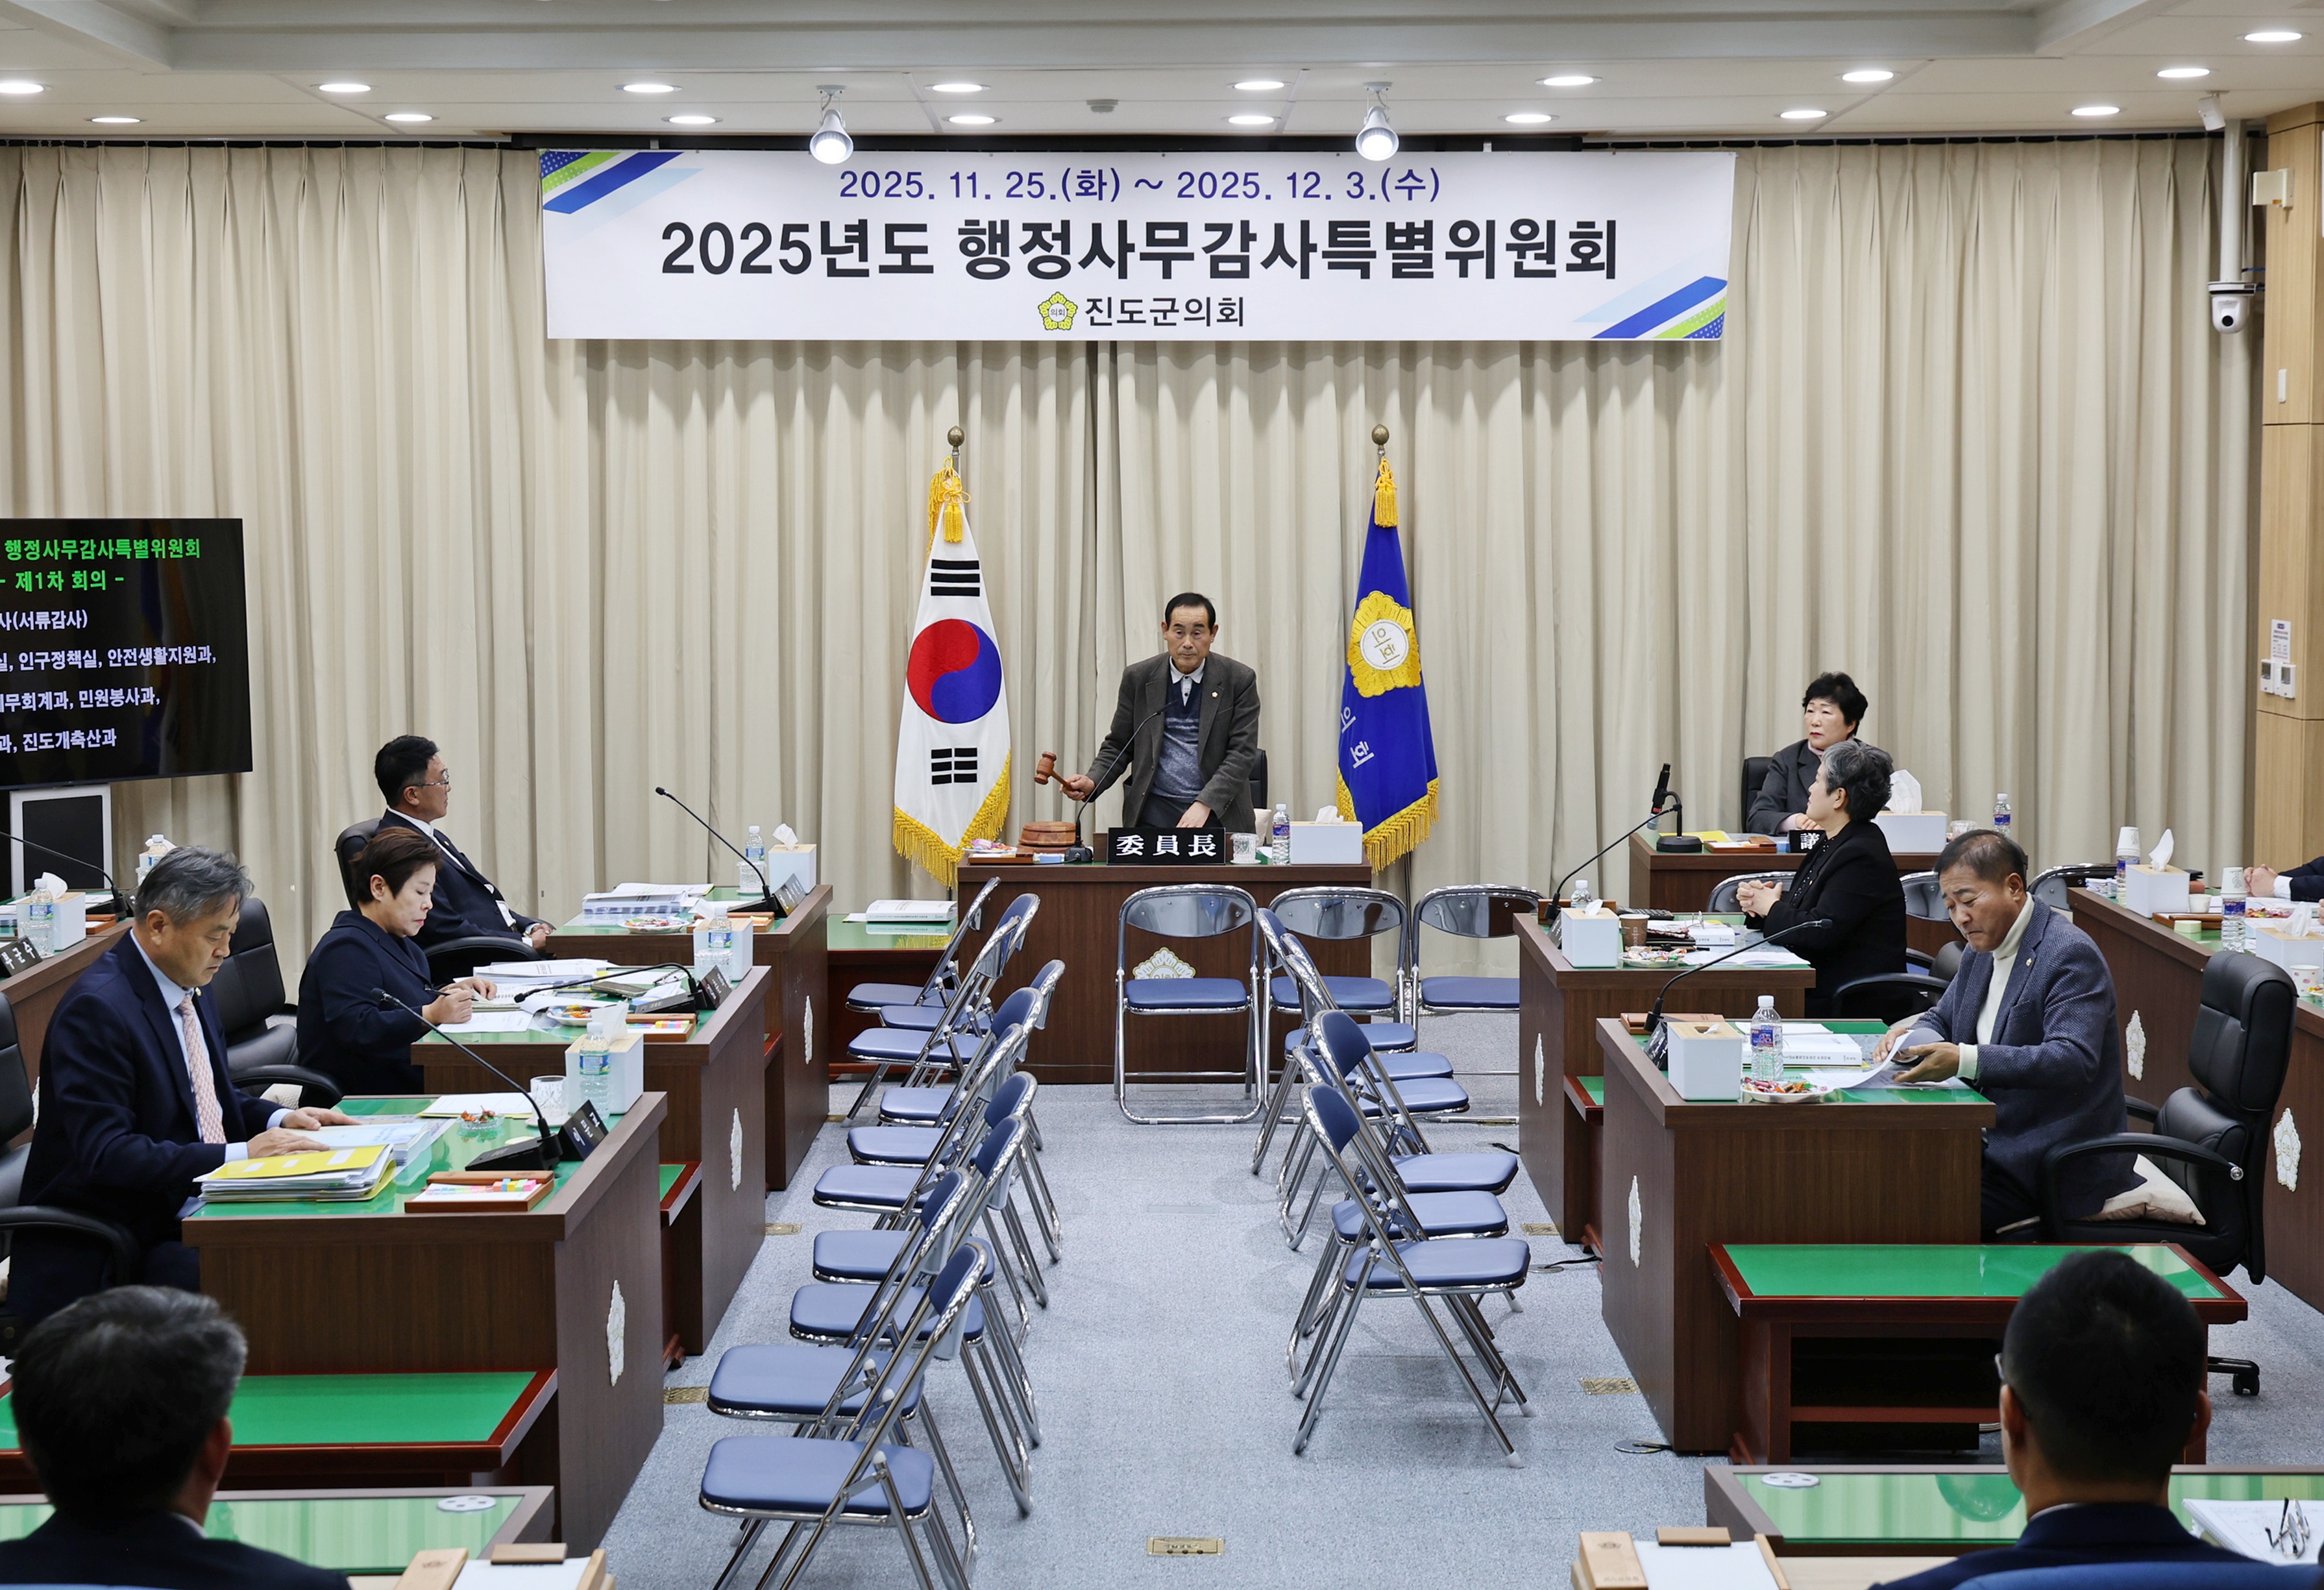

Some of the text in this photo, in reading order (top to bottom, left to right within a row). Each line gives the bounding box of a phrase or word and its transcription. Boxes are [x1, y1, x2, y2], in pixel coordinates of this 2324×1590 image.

[840, 170, 935, 200] 2025.
[949, 171, 991, 200] 11.
[1005, 167, 1120, 202] 25.(화)
[1177, 171, 1271, 201] 2025.
[1286, 171, 1332, 201] 12.
[1346, 167, 1439, 202] 3.(수)
[662, 218, 1617, 280] 2025년도 행정사무감사특별위원회
[1084, 297, 1243, 327] 진도군의회
[4, 538, 201, 561] 행정사무감사특별위원회
[15, 570, 64, 592] 제1차
[71, 570, 106, 591] 회의
[0, 609, 88, 631] 사(서류감사)
[18, 649, 103, 671] 인구정책실,
[107, 645, 217, 667] 안전생활지원과,
[79, 686, 160, 709] 민원봉사과,
[22, 728, 117, 752] 진도개축산과
[1116, 834, 1217, 857] 委員長
[1, 941, 36, 970] 부군수
